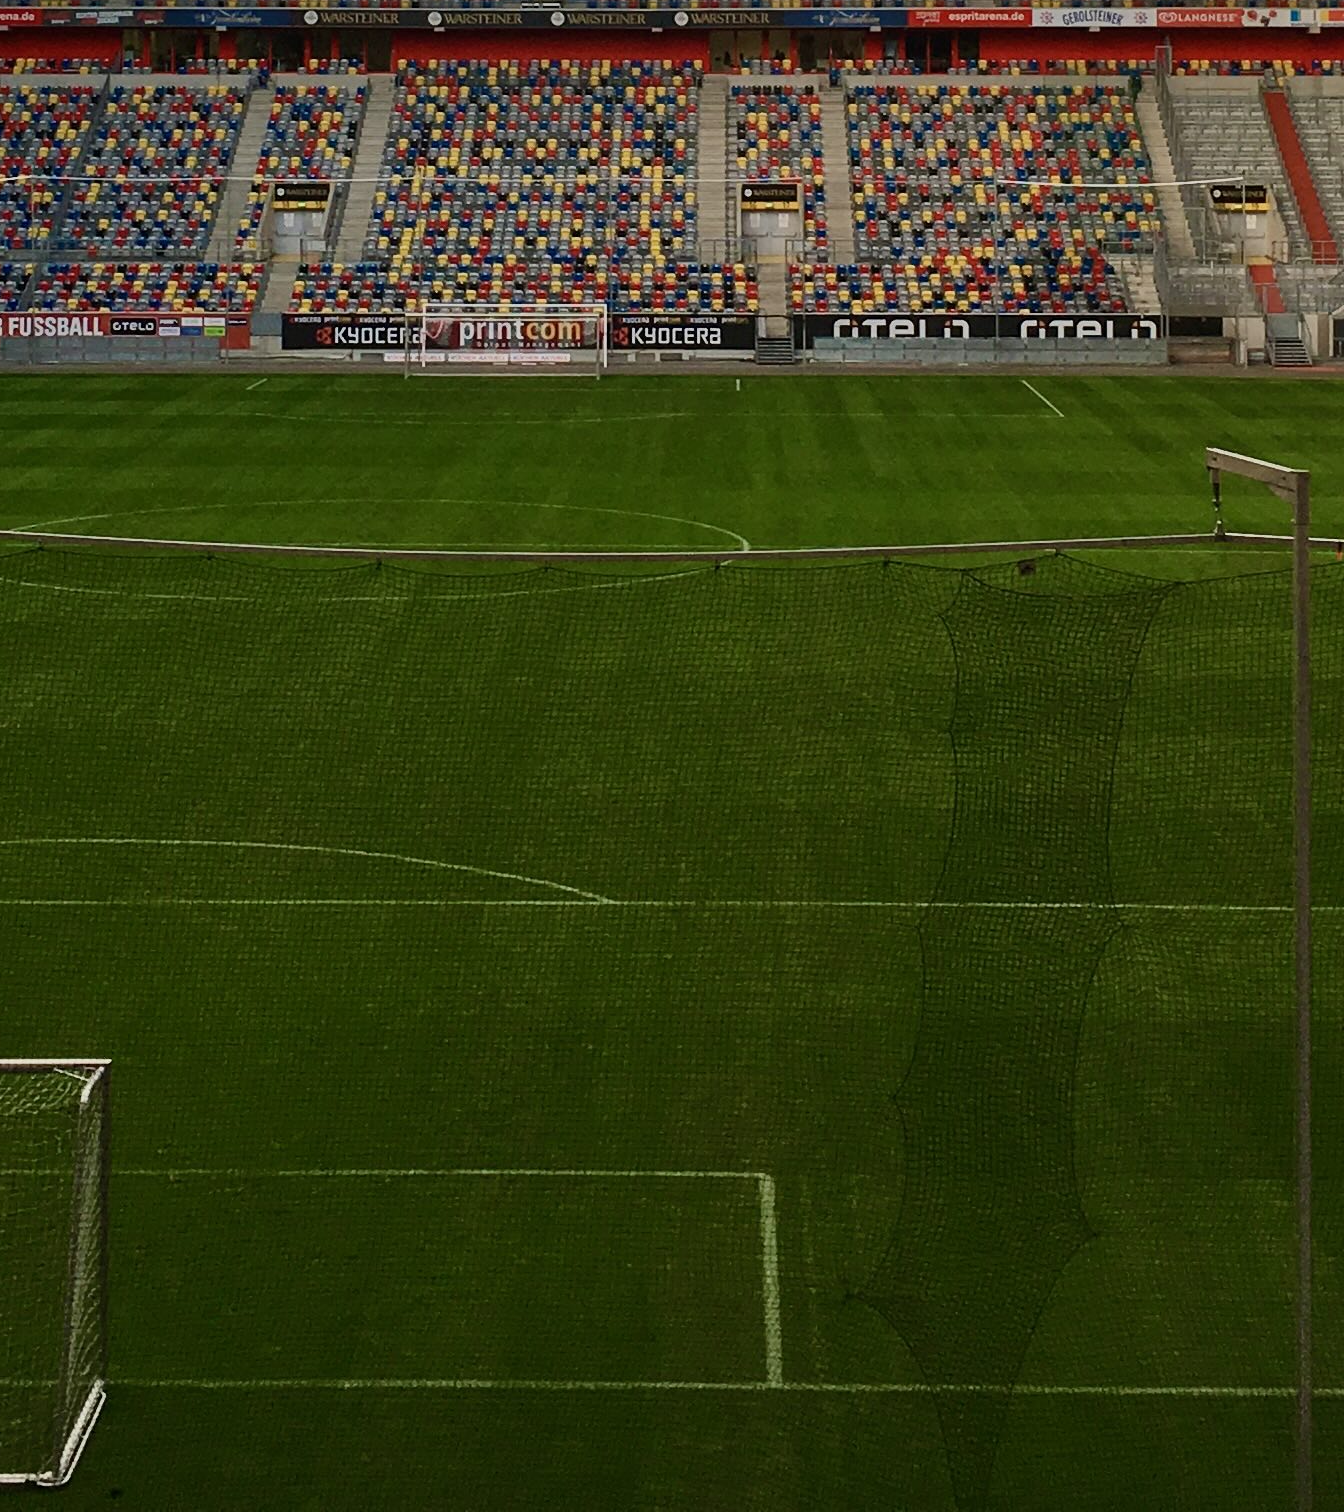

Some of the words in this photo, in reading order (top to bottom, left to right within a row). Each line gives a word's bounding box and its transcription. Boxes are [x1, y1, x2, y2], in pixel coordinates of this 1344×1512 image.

[320, 12, 400, 25] WARSTEINER
[445, 12, 522, 25] WARSTEINER
[567, 13, 646, 25] WARSTEINER
[692, 12, 770, 25] WARSTEINER
[948, 11, 1025, 23] espritarena.de
[1063, 9, 1124, 26] GEROLSTEINER
[1178, 10, 1238, 23] LANGNESE
[9, 316, 103, 337] FUSSBALL
[112, 321, 155, 331] OTELO
[334, 327, 423, 344] KYOCERA
[459, 319, 581, 347] printcom
[631, 327, 721, 345] KYOCERA
